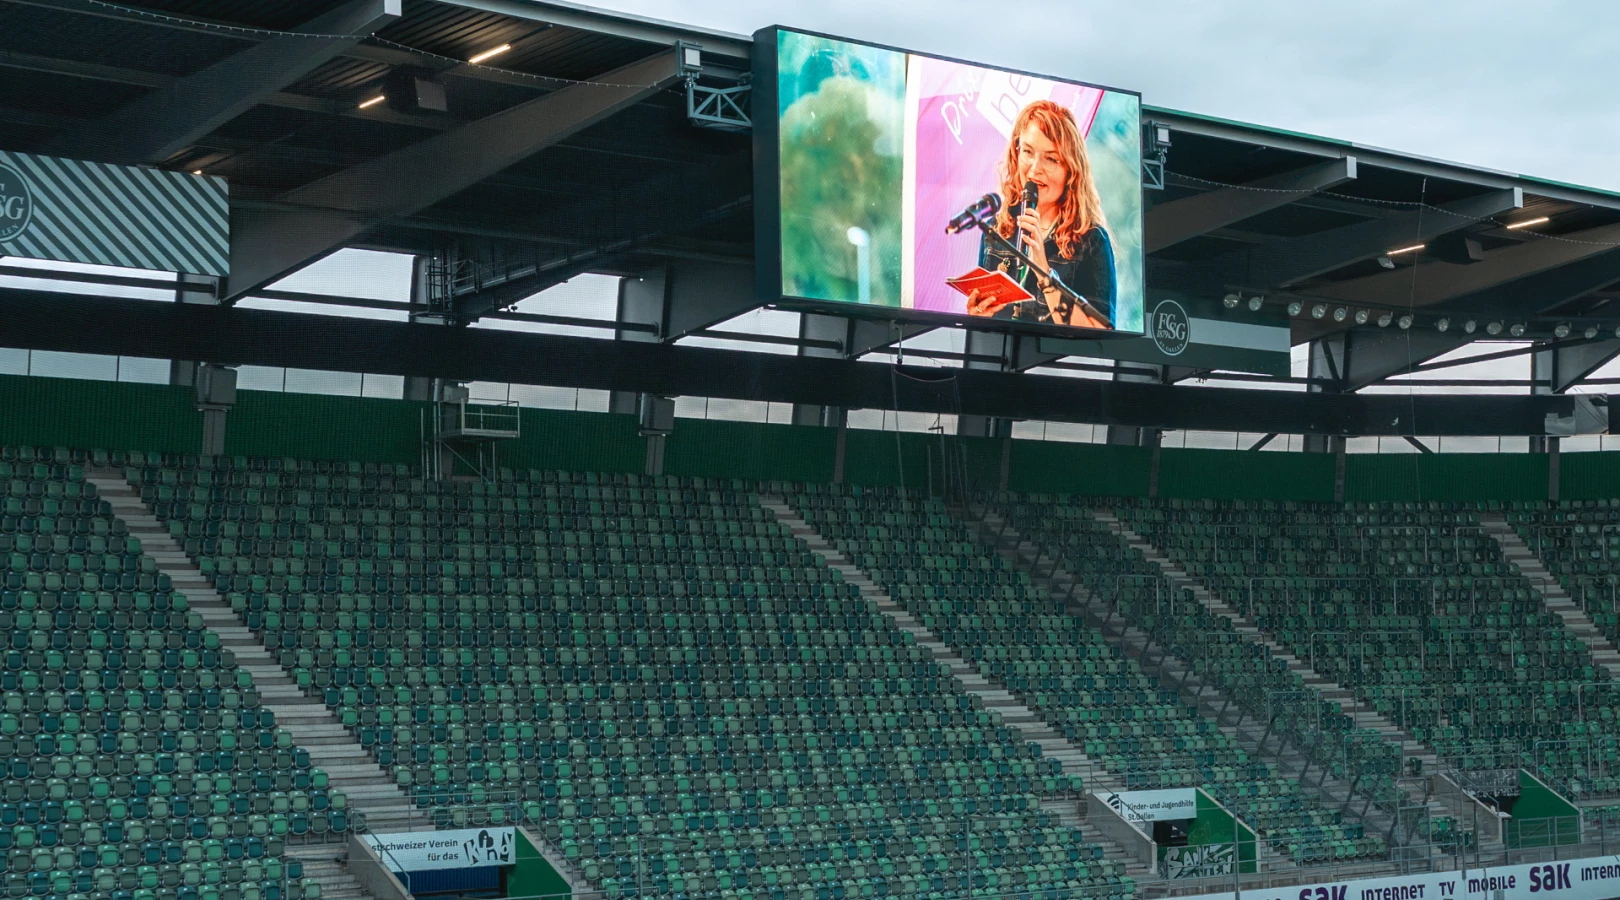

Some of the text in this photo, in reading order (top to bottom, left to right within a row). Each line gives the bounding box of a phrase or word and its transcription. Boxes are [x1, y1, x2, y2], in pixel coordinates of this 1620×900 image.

[1149, 801, 1161, 809] und
[1161, 799, 1194, 810] Jugendhilfe
[428, 839, 459, 849] Verein
[427, 852, 440, 861] für
[442, 852, 459, 860] das
[1439, 881, 1456, 896] TV
